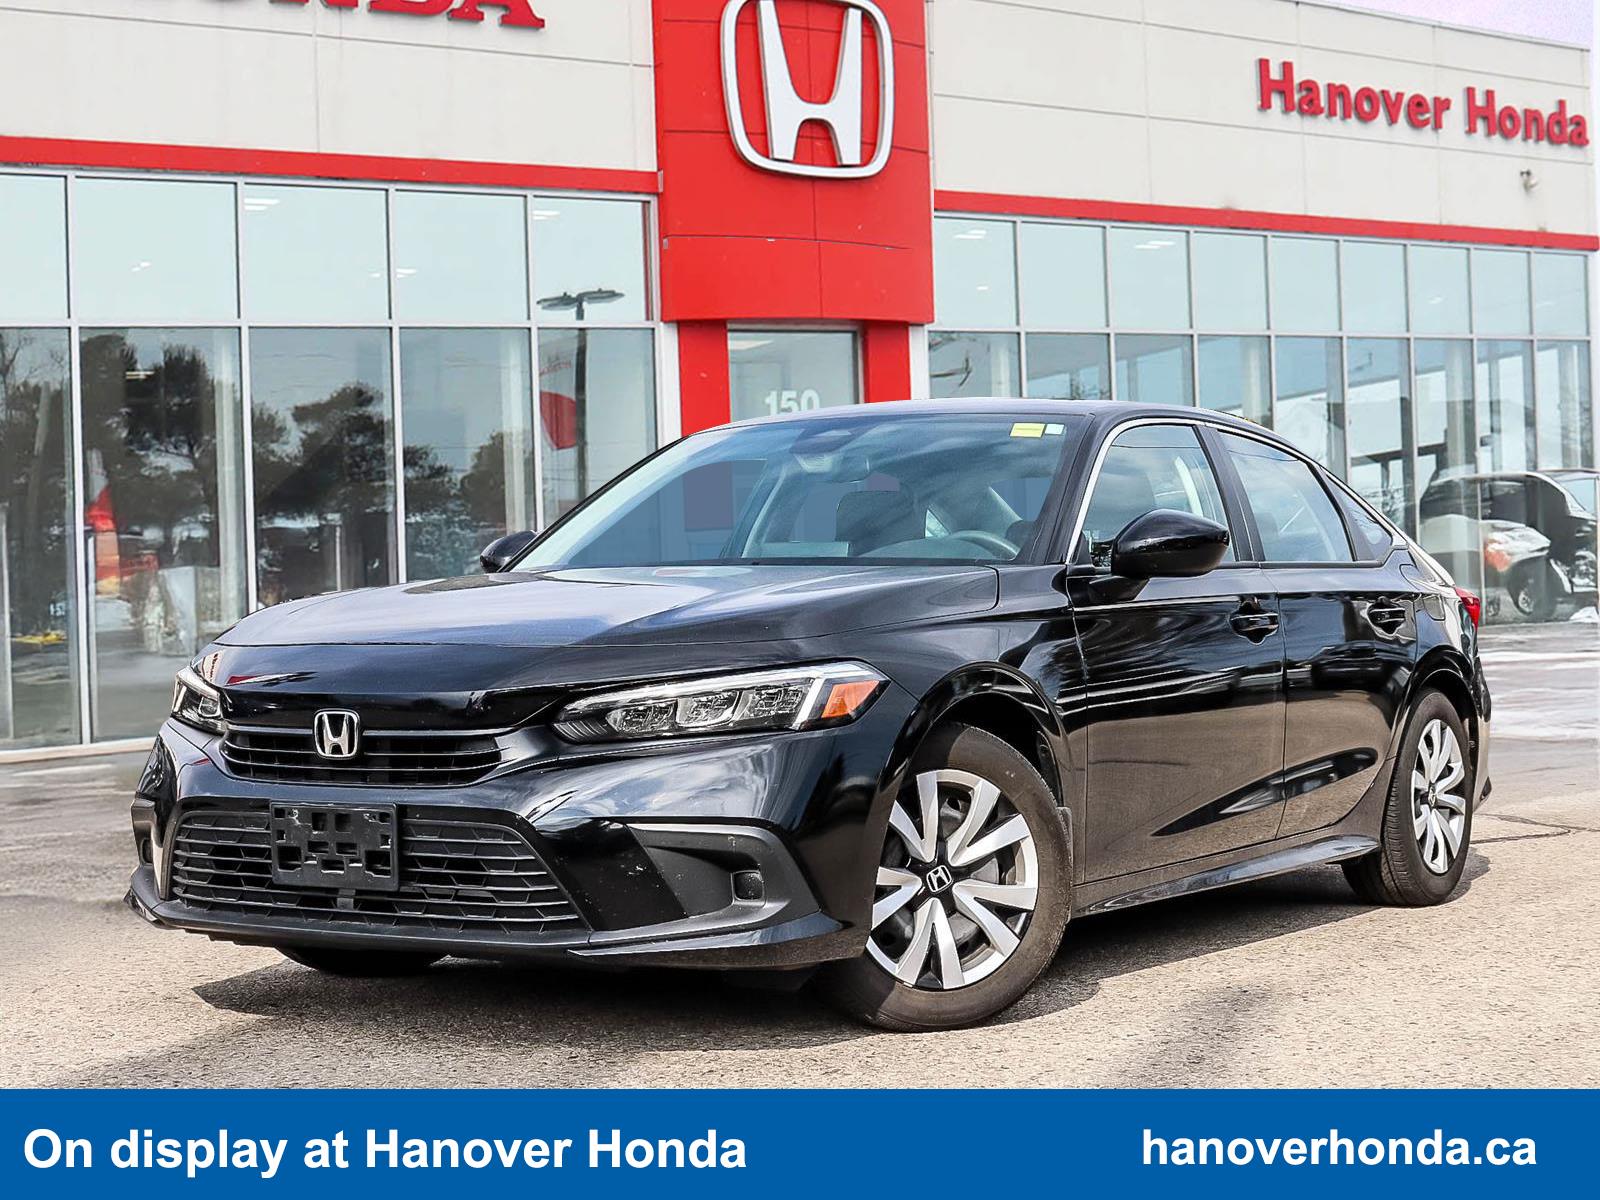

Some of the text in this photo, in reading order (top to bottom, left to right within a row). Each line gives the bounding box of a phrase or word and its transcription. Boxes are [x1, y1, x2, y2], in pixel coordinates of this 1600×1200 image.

[1257, 57, 1590, 147] Hanover Honda
[764, 389, 821, 416] 150
